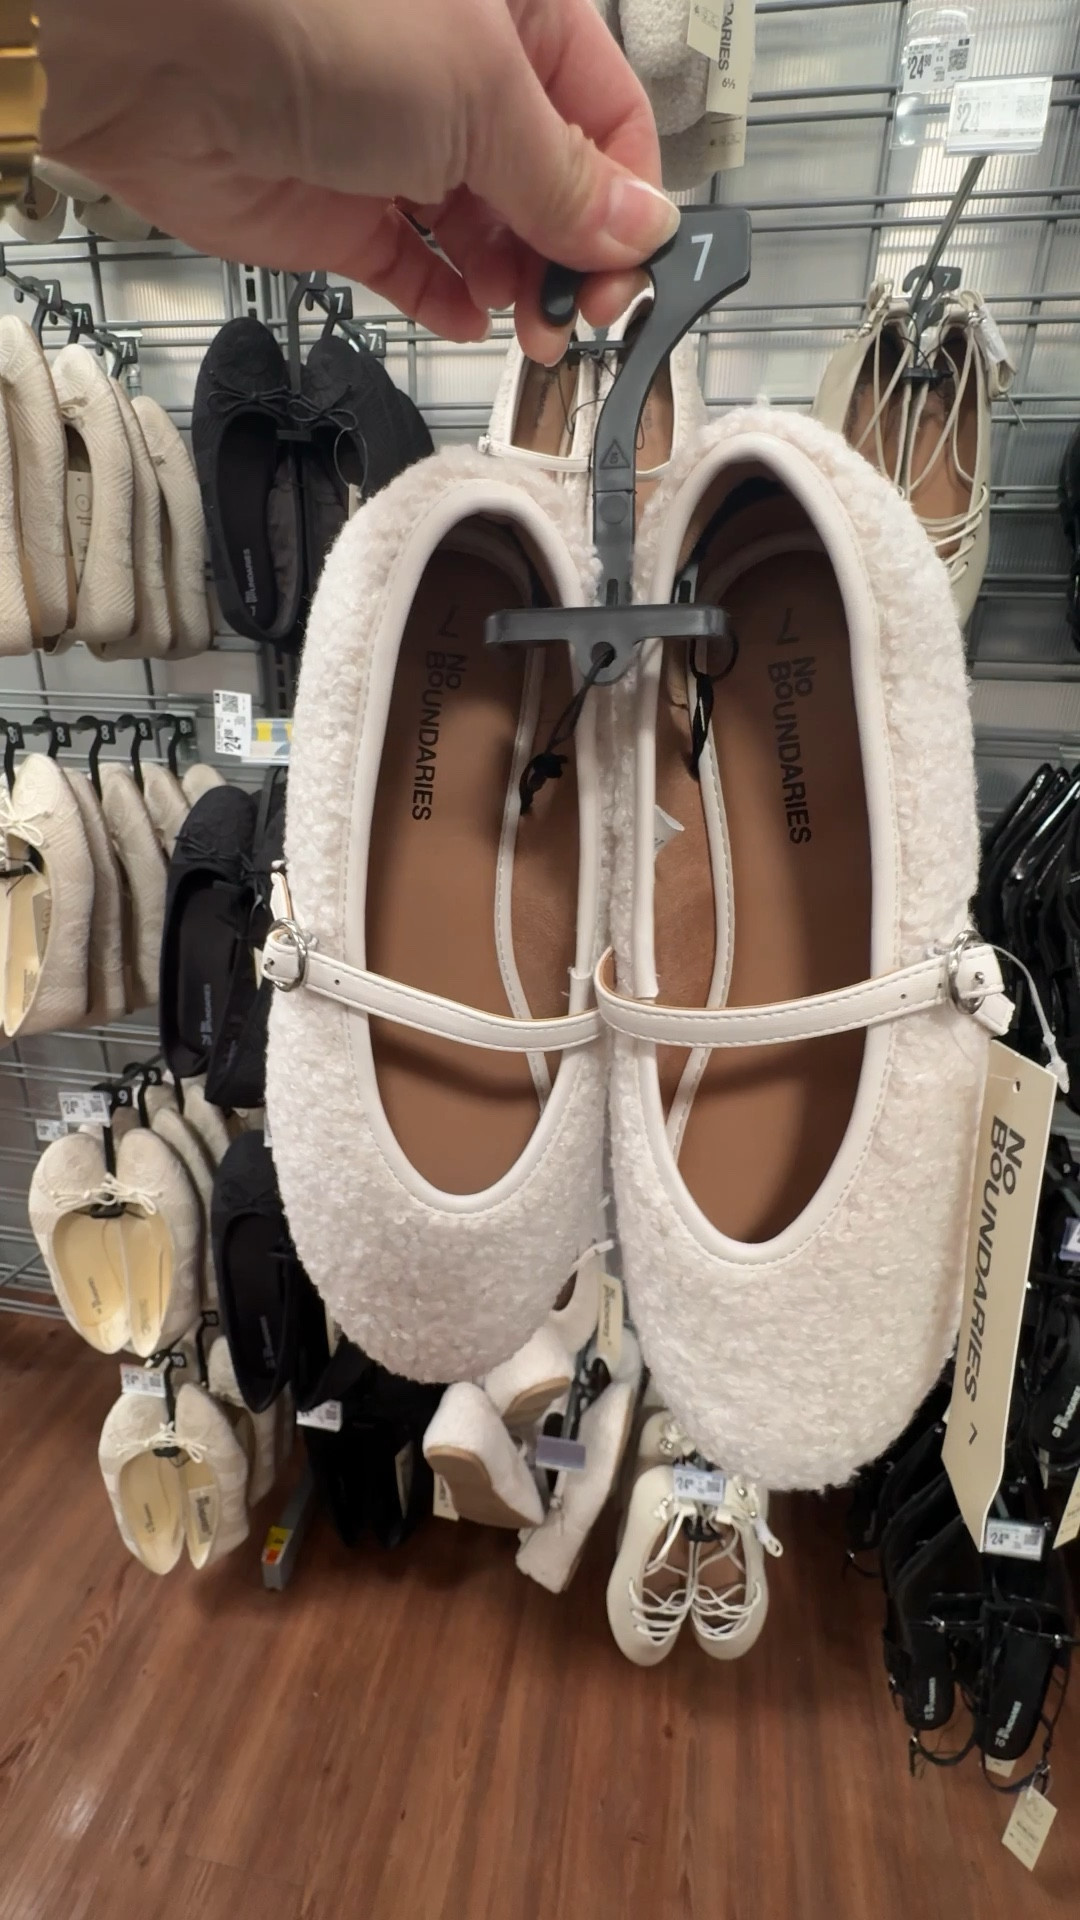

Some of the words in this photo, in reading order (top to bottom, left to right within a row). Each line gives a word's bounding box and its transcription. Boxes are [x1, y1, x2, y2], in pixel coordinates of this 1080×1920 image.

[691, 233, 714, 282] 7
[44, 284, 54, 304] 7
[943, 272, 952, 288] 7
[334, 292, 344, 314] 7
[446, 653, 469, 690] NO
[791, 656, 817, 698] NO
[411, 650, 447, 822] BOUNDARIES
[767, 660, 812, 845] BOUNDARIES
[118, 1089, 129, 1104] 9
[1003, 1128, 1026, 1195] NO
[964, 1115, 1008, 1402] BOUNDARIES
